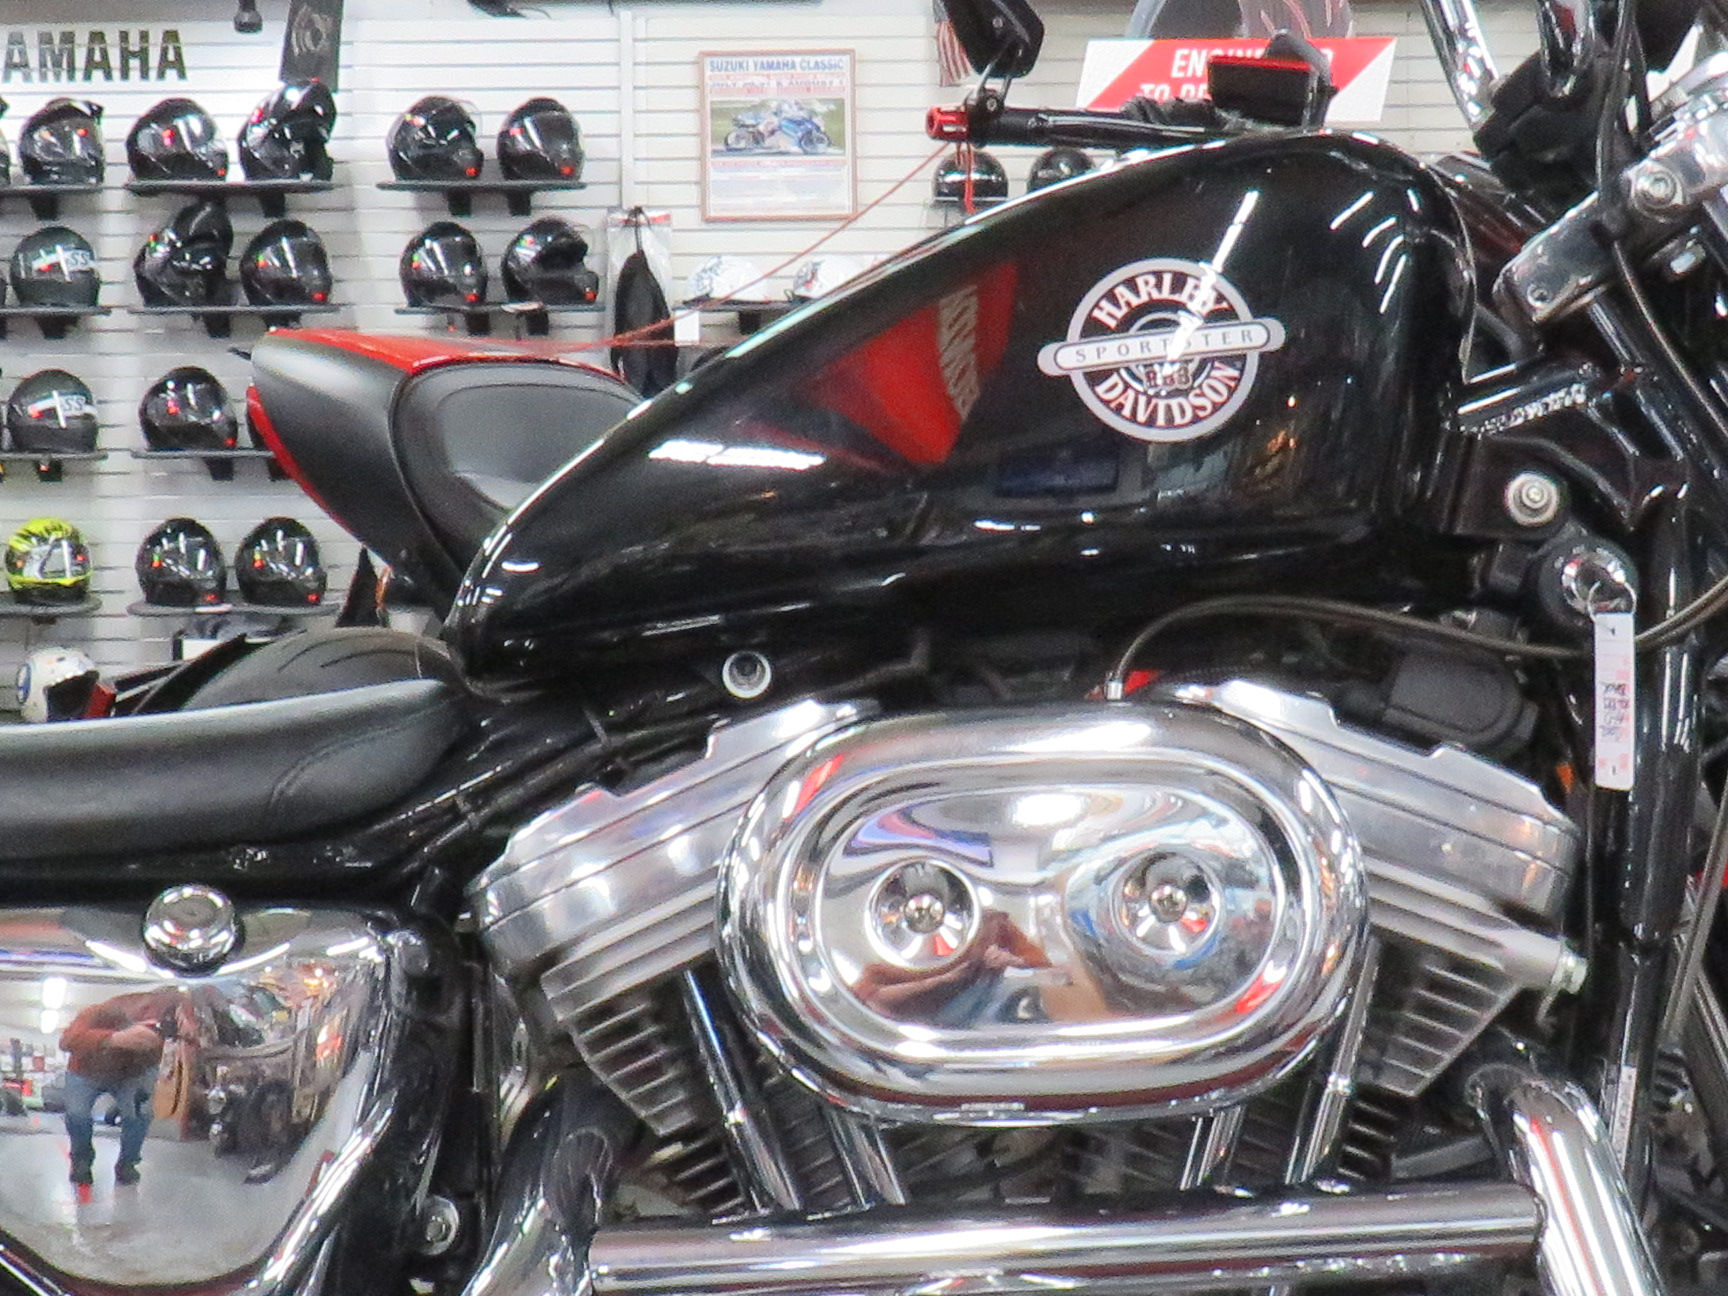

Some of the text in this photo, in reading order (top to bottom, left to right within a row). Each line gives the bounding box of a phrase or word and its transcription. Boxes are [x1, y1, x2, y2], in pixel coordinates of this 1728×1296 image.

[709, 58, 845, 72] SUZUKI YAMAHA CLASSIC
[1091, 273, 1229, 330] HARLEY
[1076, 330, 1254, 364] SPORTSTER
[1094, 359, 1242, 428] DAVIDSON
